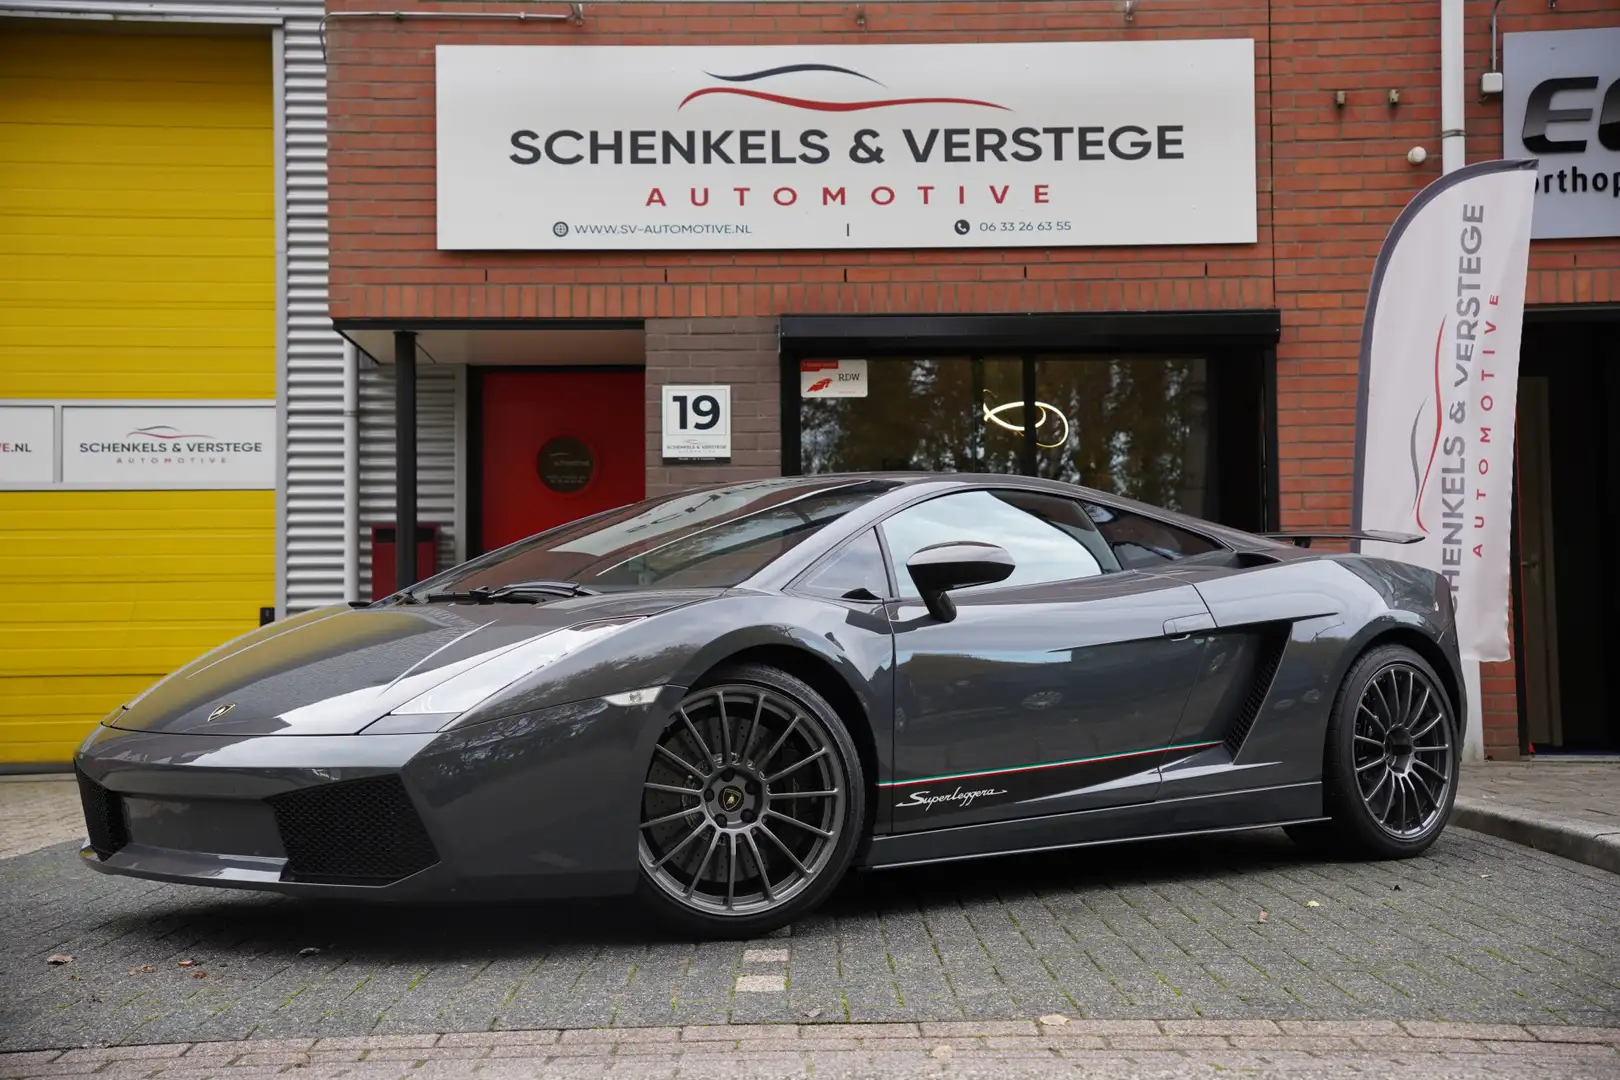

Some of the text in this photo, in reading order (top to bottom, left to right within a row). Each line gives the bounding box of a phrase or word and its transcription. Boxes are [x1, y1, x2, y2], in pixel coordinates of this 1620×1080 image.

[509, 125, 1185, 165] SCHENKELS & VERSTEGE
[1535, 166, 1620, 198] rthop
[645, 184, 1050, 207] AUTOMOTIVE
[574, 224, 753, 235] WWW.SV-AUTOMOTIVE.NL
[979, 221, 1072, 232] 06 33 26 63 55
[838, 373, 860, 382] RDW
[672, 394, 721, 431] 19
[1441, 203, 1485, 612] HENKELS & VERSTEGE
[1472, 294, 1500, 558] AUTOMOTIVE
[0, 443, 33, 453] E.NL
[79, 442, 262, 453] SCHENKELS & VERSTEGE
[116, 456, 227, 465] AUTOMOTIVE
[895, 786, 1008, 812] Superleggera
